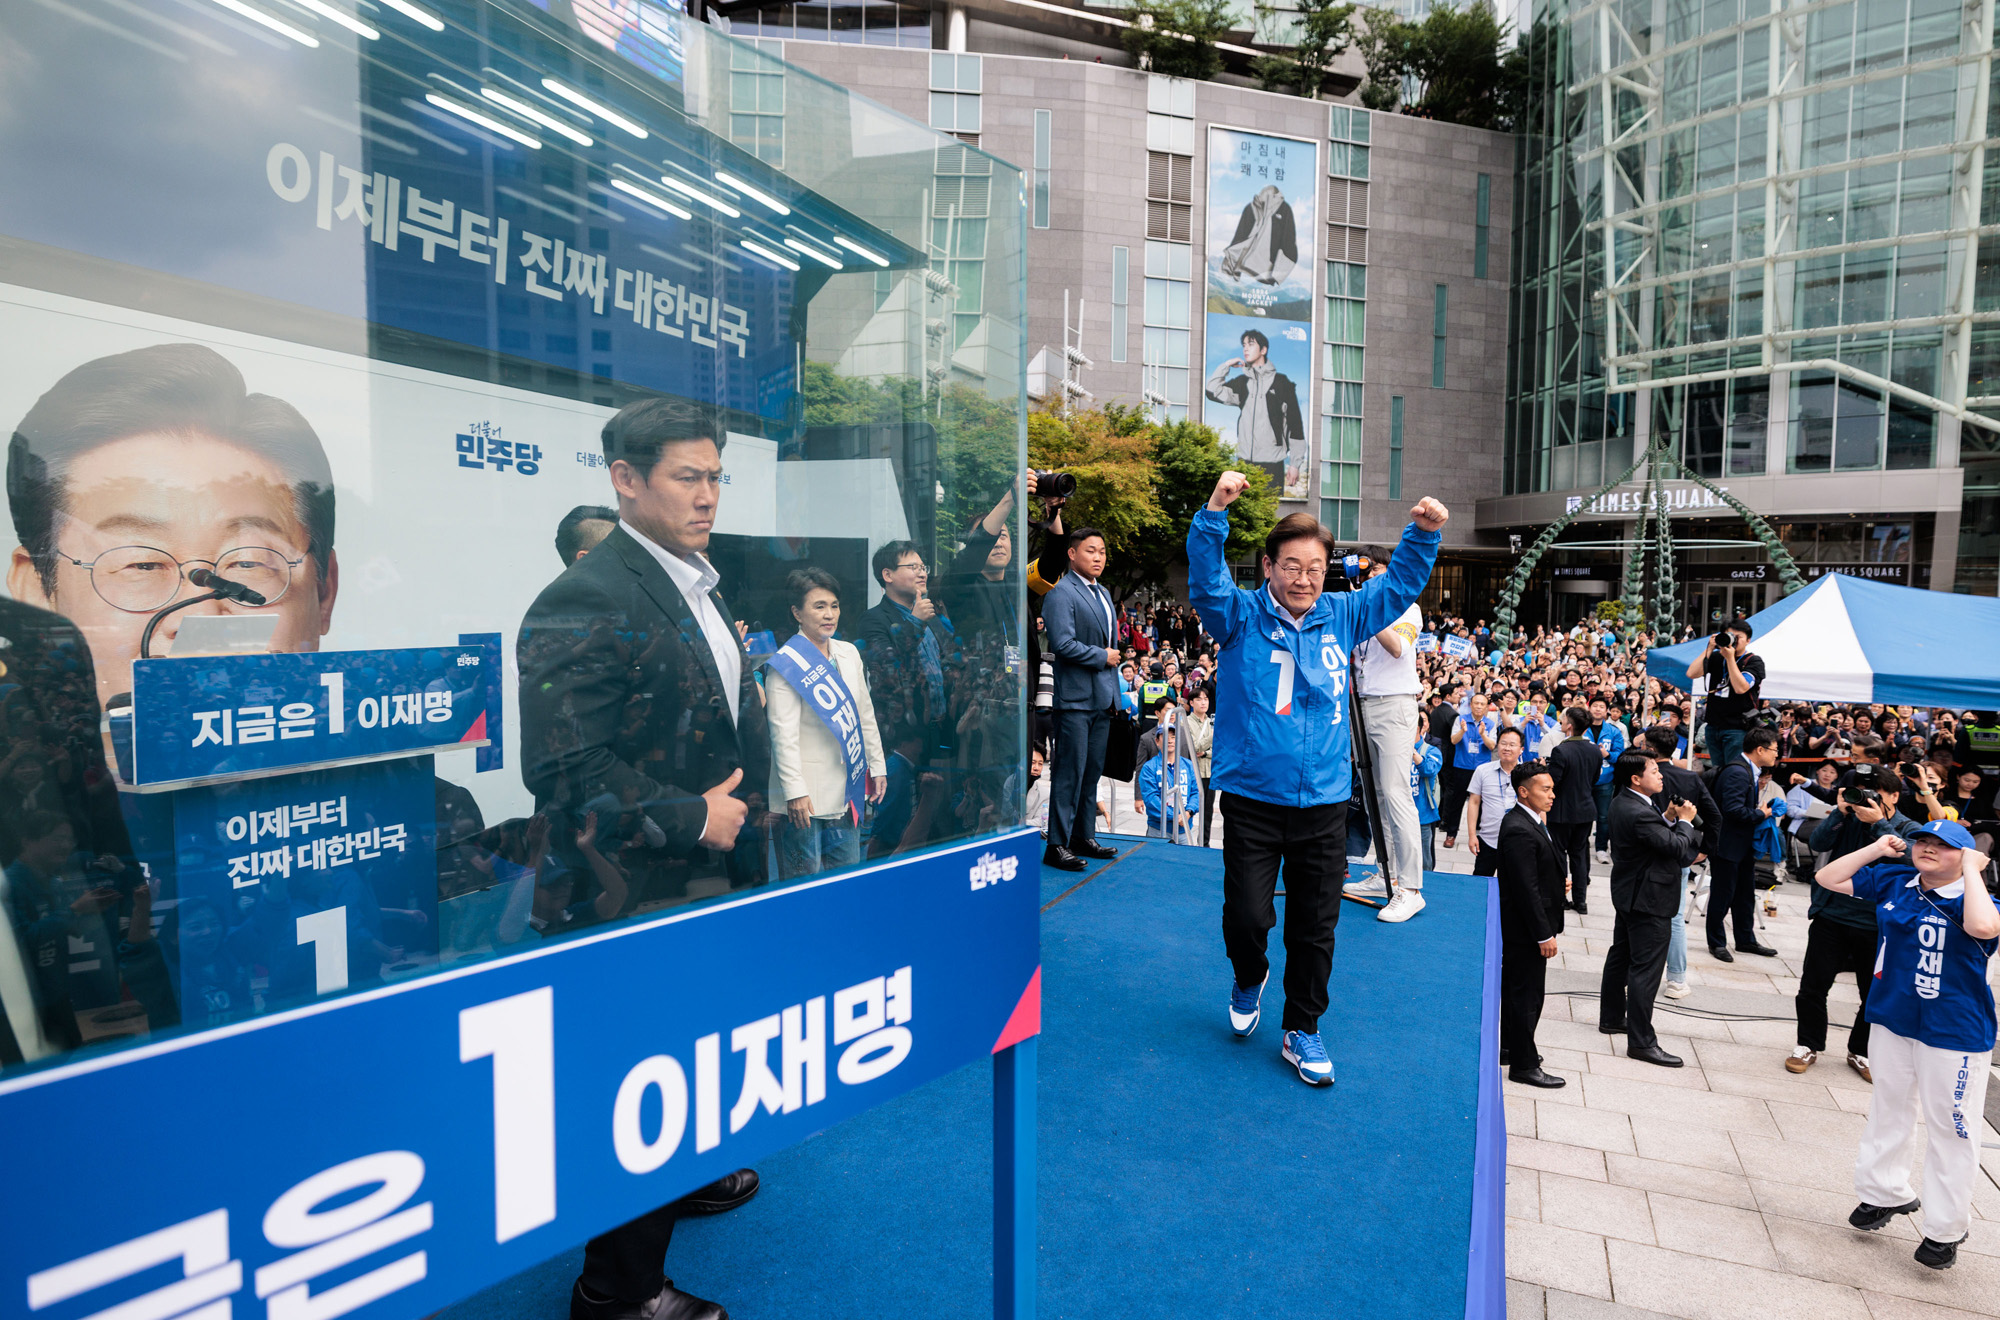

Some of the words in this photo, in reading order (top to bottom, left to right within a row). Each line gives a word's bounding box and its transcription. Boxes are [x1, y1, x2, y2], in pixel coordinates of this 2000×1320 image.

[1240, 141, 1286, 159] 마침내
[1240, 163, 1285, 181] 쾌적함
[266, 142, 508, 285] 이제부터
[518, 229, 607, 316] 진짜
[615, 268, 750, 358] 대한민국
[1241, 292, 1278, 302] MOUNTAIN
[1247, 299, 1273, 307] JACKET
[469, 420, 502, 439] 더불어
[455, 433, 543, 476] 민주당
[1591, 491, 1642, 513] TIMES
[1650, 486, 1729, 513] SQUARE
[1560, 567, 1574, 576] TIMES
[1574, 567, 1591, 576] SQUARE
[1731, 571, 1755, 579] GATE
[1755, 565, 1766, 578] 3
[1824, 567, 1856, 577] TIMES
[1859, 566, 1902, 577] SQUARE
[457, 656, 480, 667] 민주당
[777, 644, 812, 672] 1
[801, 664, 827, 689] 지금은
[1270, 649, 1295, 716] 1
[192, 702, 316, 748] 지금은
[320, 671, 345, 735] 1
[358, 690, 453, 729] 이재명
[813, 674, 861, 765] 이재명
[226, 796, 348, 845] 이제부터
[1932, 821, 1943, 832] 1
[227, 847, 293, 890] 진짜
[297, 823, 408, 870] 대한민국
[969, 855, 1019, 891] 민주당
[296, 905, 348, 996] 1
[1914, 923, 1946, 1000] 이재명
[1961, 1055, 1969, 1069] 1
[1954, 1070, 1969, 1101] 이재명
[459, 986, 557, 1243] 1
[612, 965, 913, 1174] 이재명
